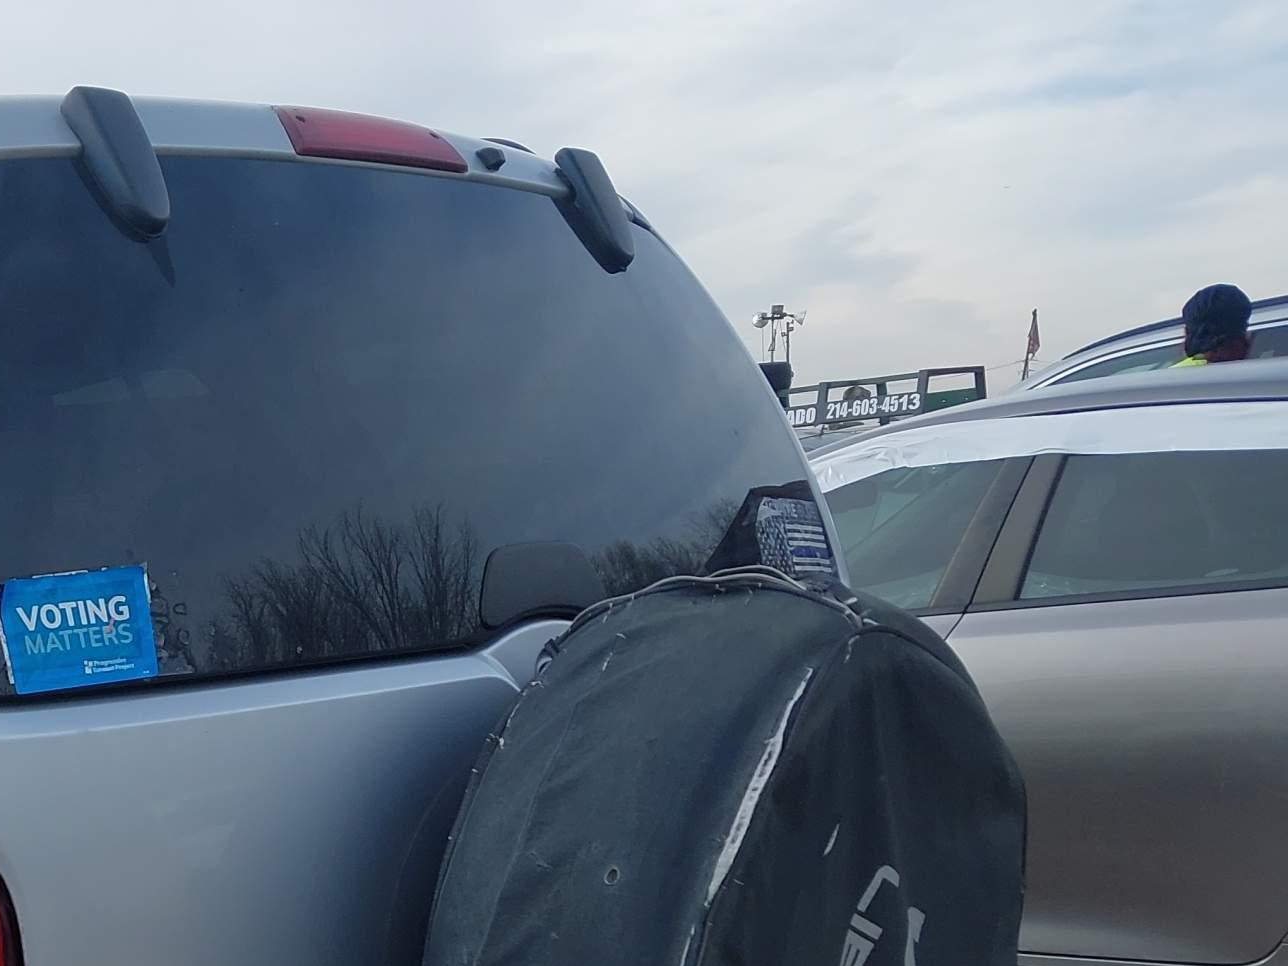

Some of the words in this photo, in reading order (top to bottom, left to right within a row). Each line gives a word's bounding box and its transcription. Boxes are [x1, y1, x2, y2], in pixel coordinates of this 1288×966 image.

[825, 393, 921, 419] 214-603-4513
[15, 595, 130, 632] VOTING
[24, 623, 133, 655] MATTERS
